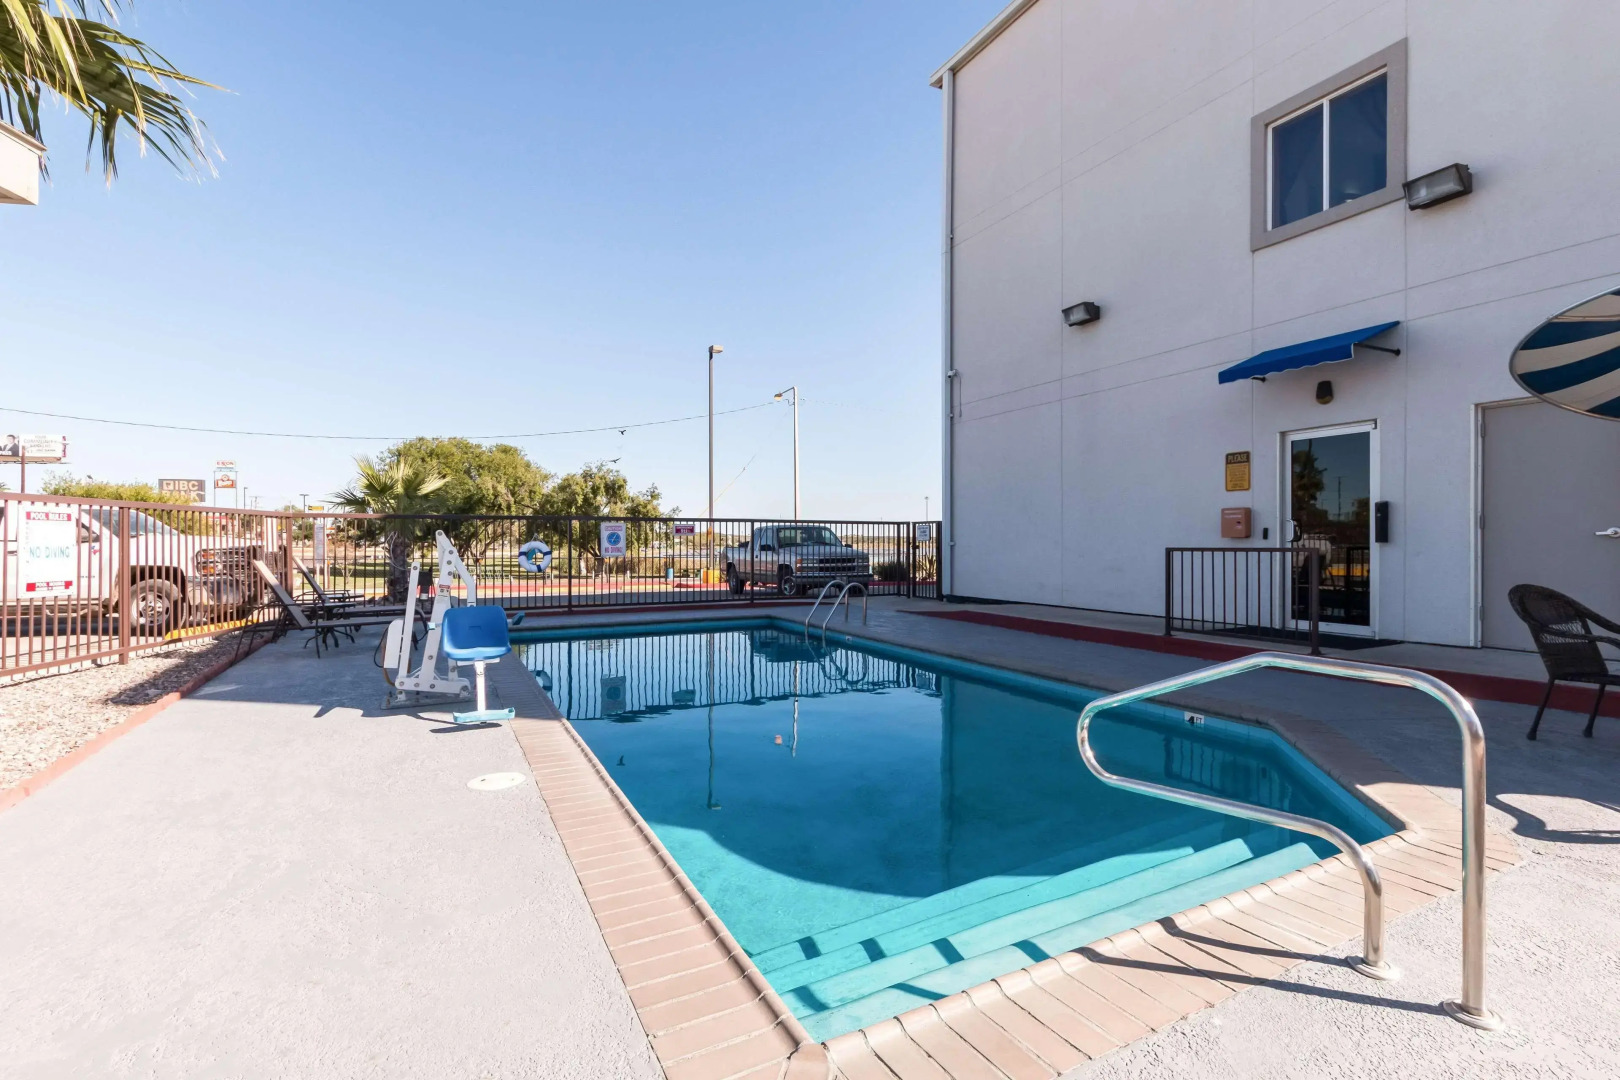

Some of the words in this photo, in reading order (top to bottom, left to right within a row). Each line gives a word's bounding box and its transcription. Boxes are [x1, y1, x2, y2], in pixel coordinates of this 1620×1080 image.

[1227, 453, 1248, 463] PLEASE
[174, 480, 199, 491] IBC
[30, 511, 46, 520] POOL
[29, 546, 41, 558] NO
[45, 546, 71, 558] DIVING
